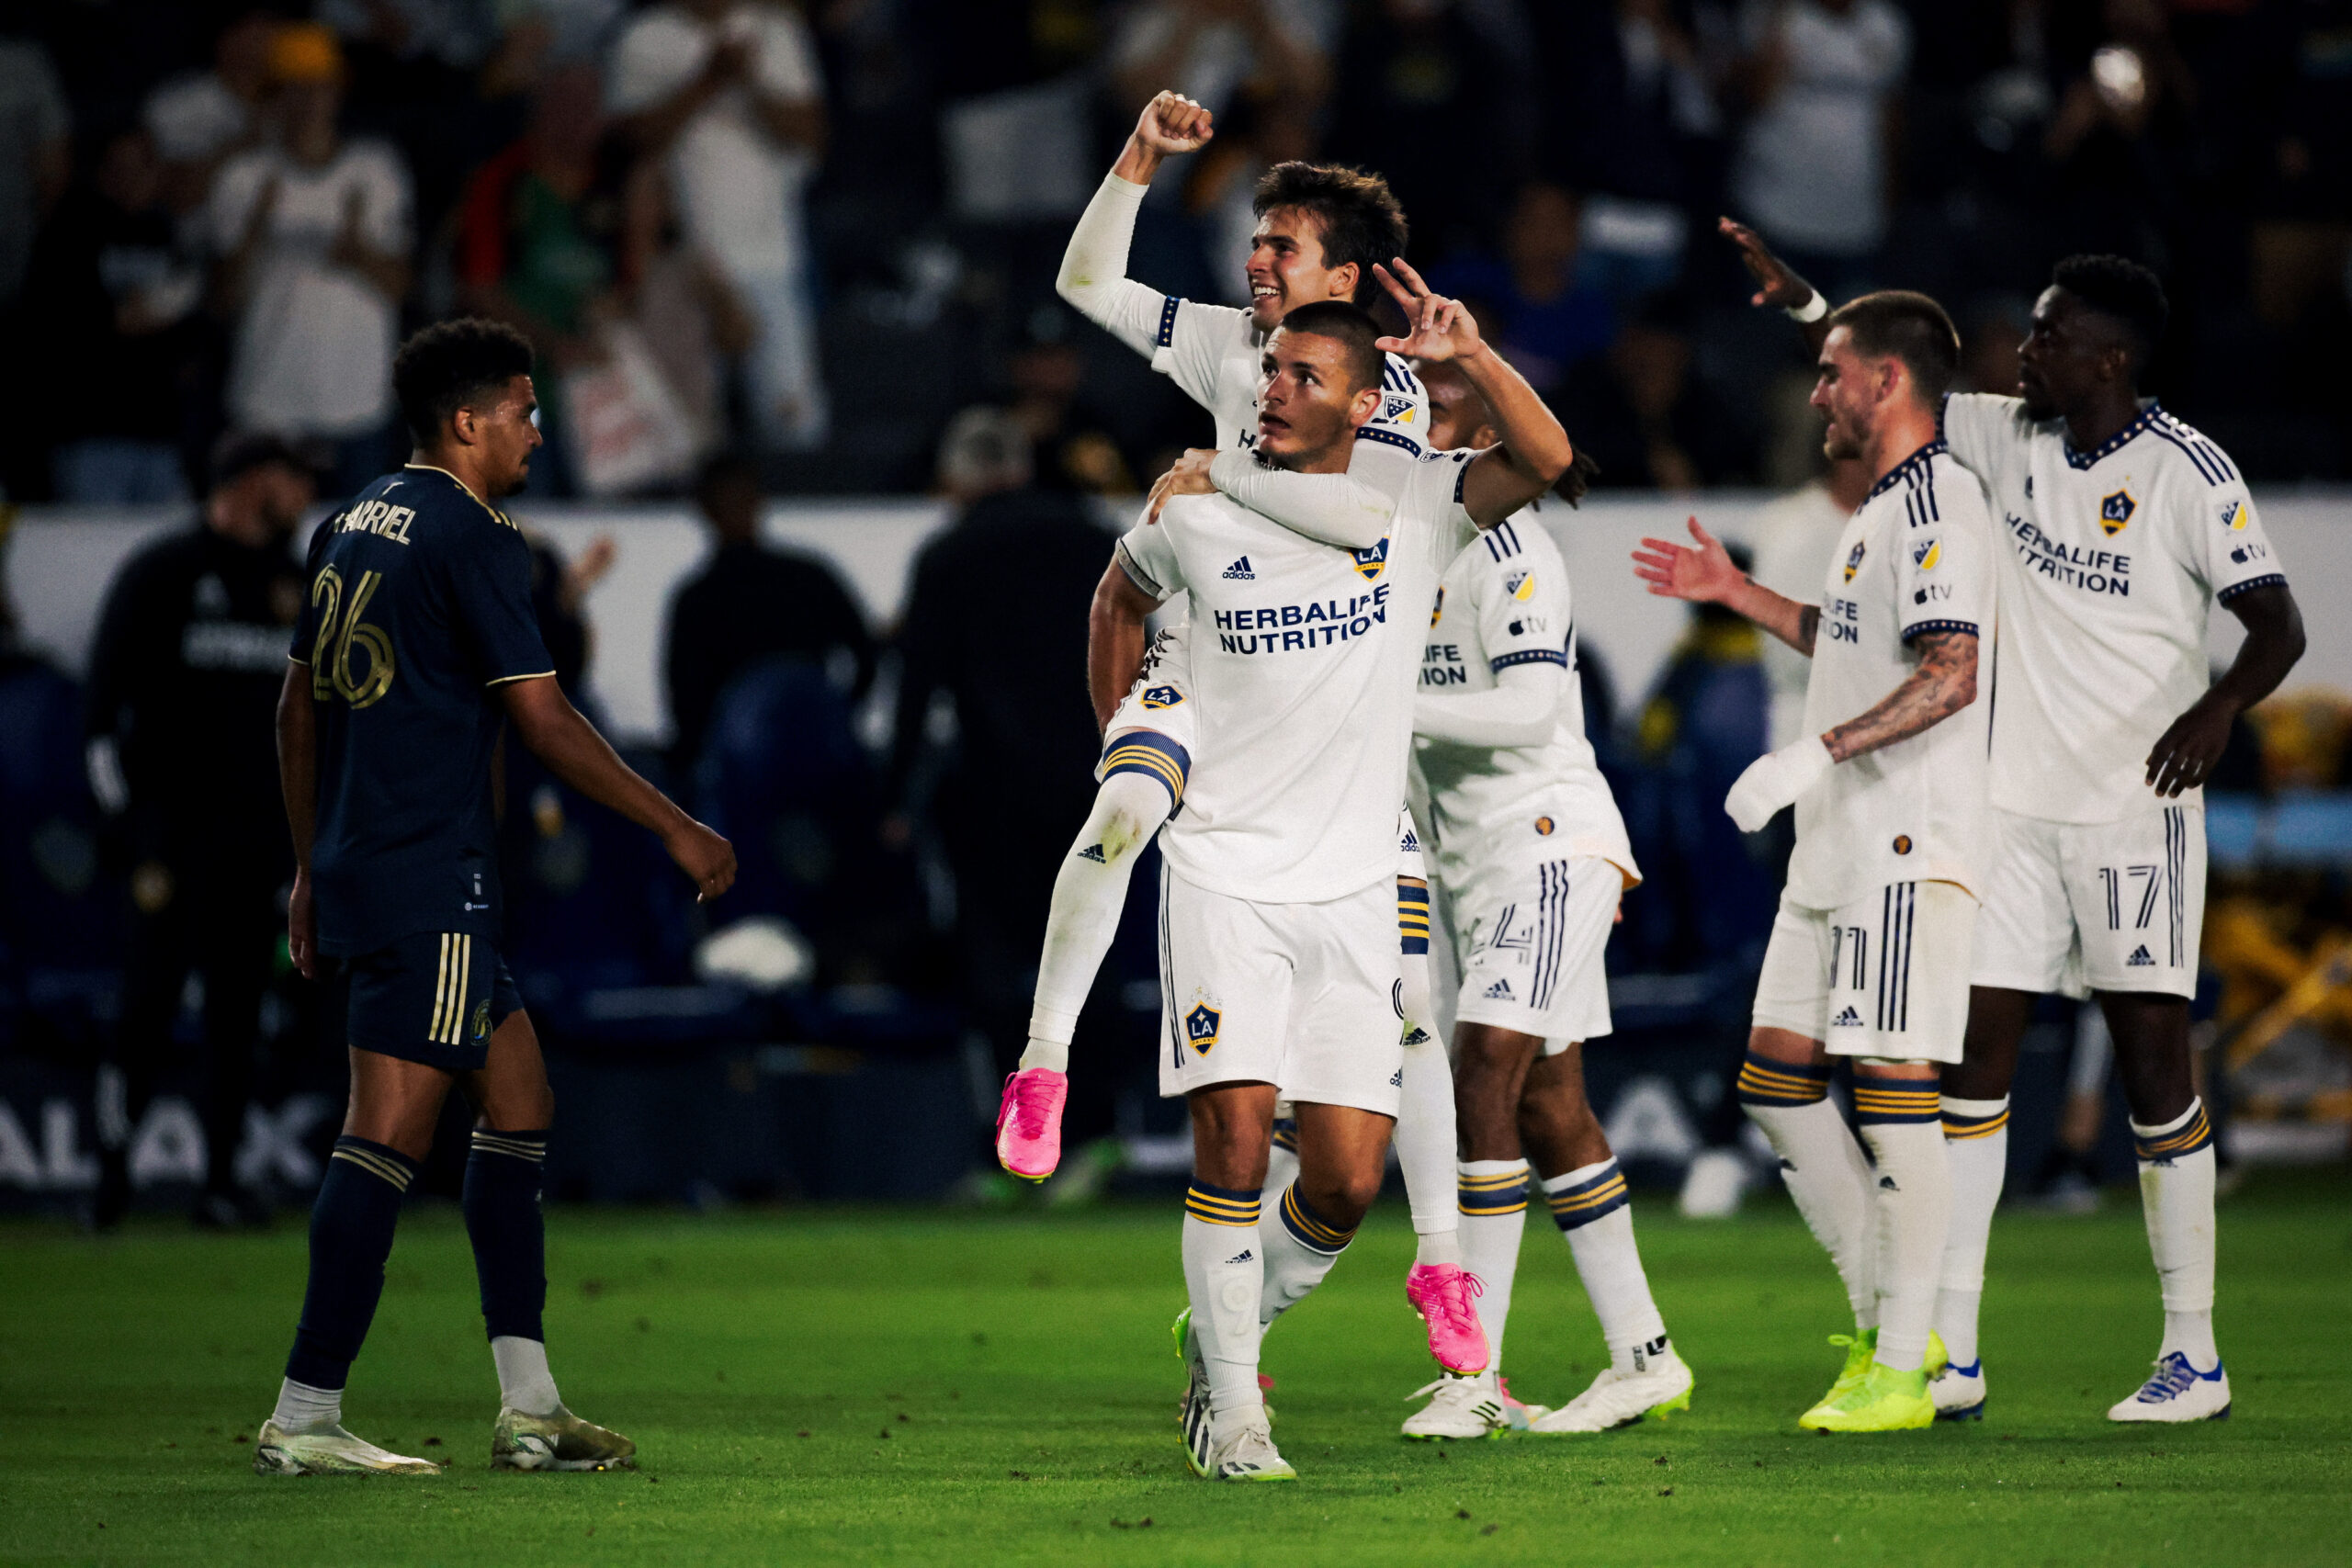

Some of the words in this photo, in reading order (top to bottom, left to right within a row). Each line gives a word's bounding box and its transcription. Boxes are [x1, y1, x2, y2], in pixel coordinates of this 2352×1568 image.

[1388, 399, 1407, 408] MLS
[2105, 505, 2125, 520] LA
[1359, 546, 1383, 562] LA
[1222, 570, 1256, 581] adidas
[1930, 584, 1951, 600] tv
[1214, 582, 1390, 631] HERBALIFE
[1219, 604, 1386, 655] NUTRITION
[1526, 616, 1547, 633] tv
[312, 563, 395, 710] 26
[1423, 644, 1462, 662] IFE
[1421, 666, 1466, 686] ION
[1147, 692, 1170, 704] LA
[1077, 852, 1106, 864] adidas
[2098, 865, 2163, 930] 17
[1830, 926, 1867, 990] 11
[1191, 1021, 1213, 1036] LA
